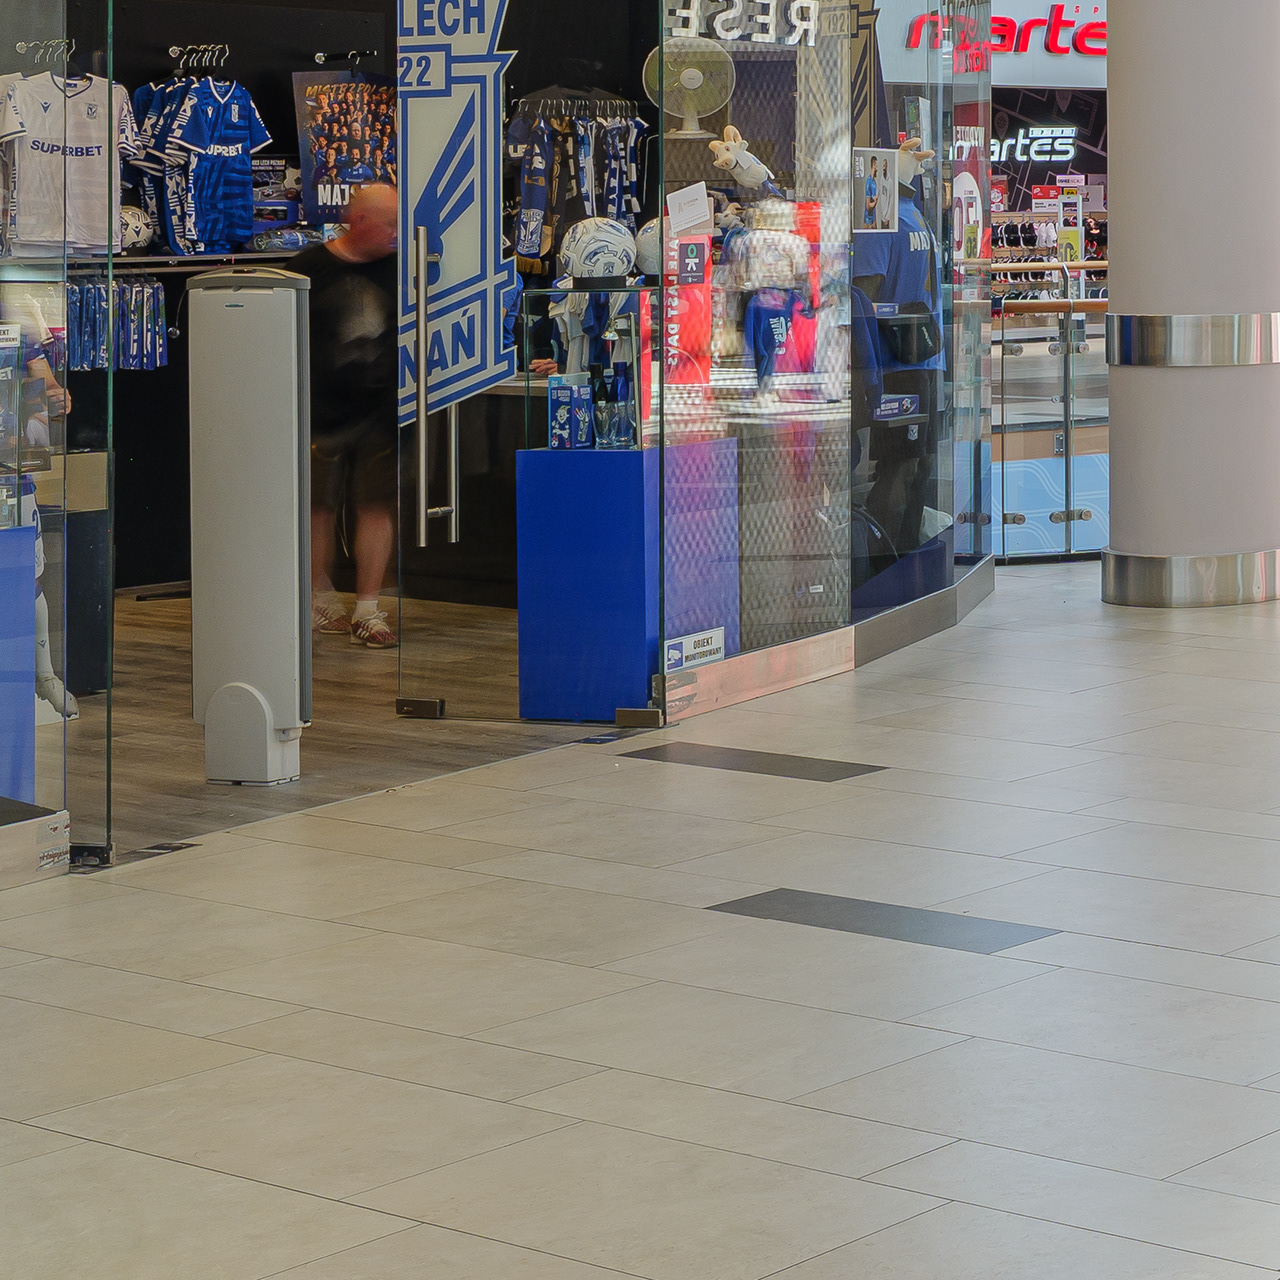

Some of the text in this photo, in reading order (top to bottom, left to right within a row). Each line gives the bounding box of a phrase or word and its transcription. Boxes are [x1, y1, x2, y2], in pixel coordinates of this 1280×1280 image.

[905, 3, 1107, 55] marte
[30, 139, 103, 157] SUPERBET
[693, 635, 713, 650] OBIEKT
